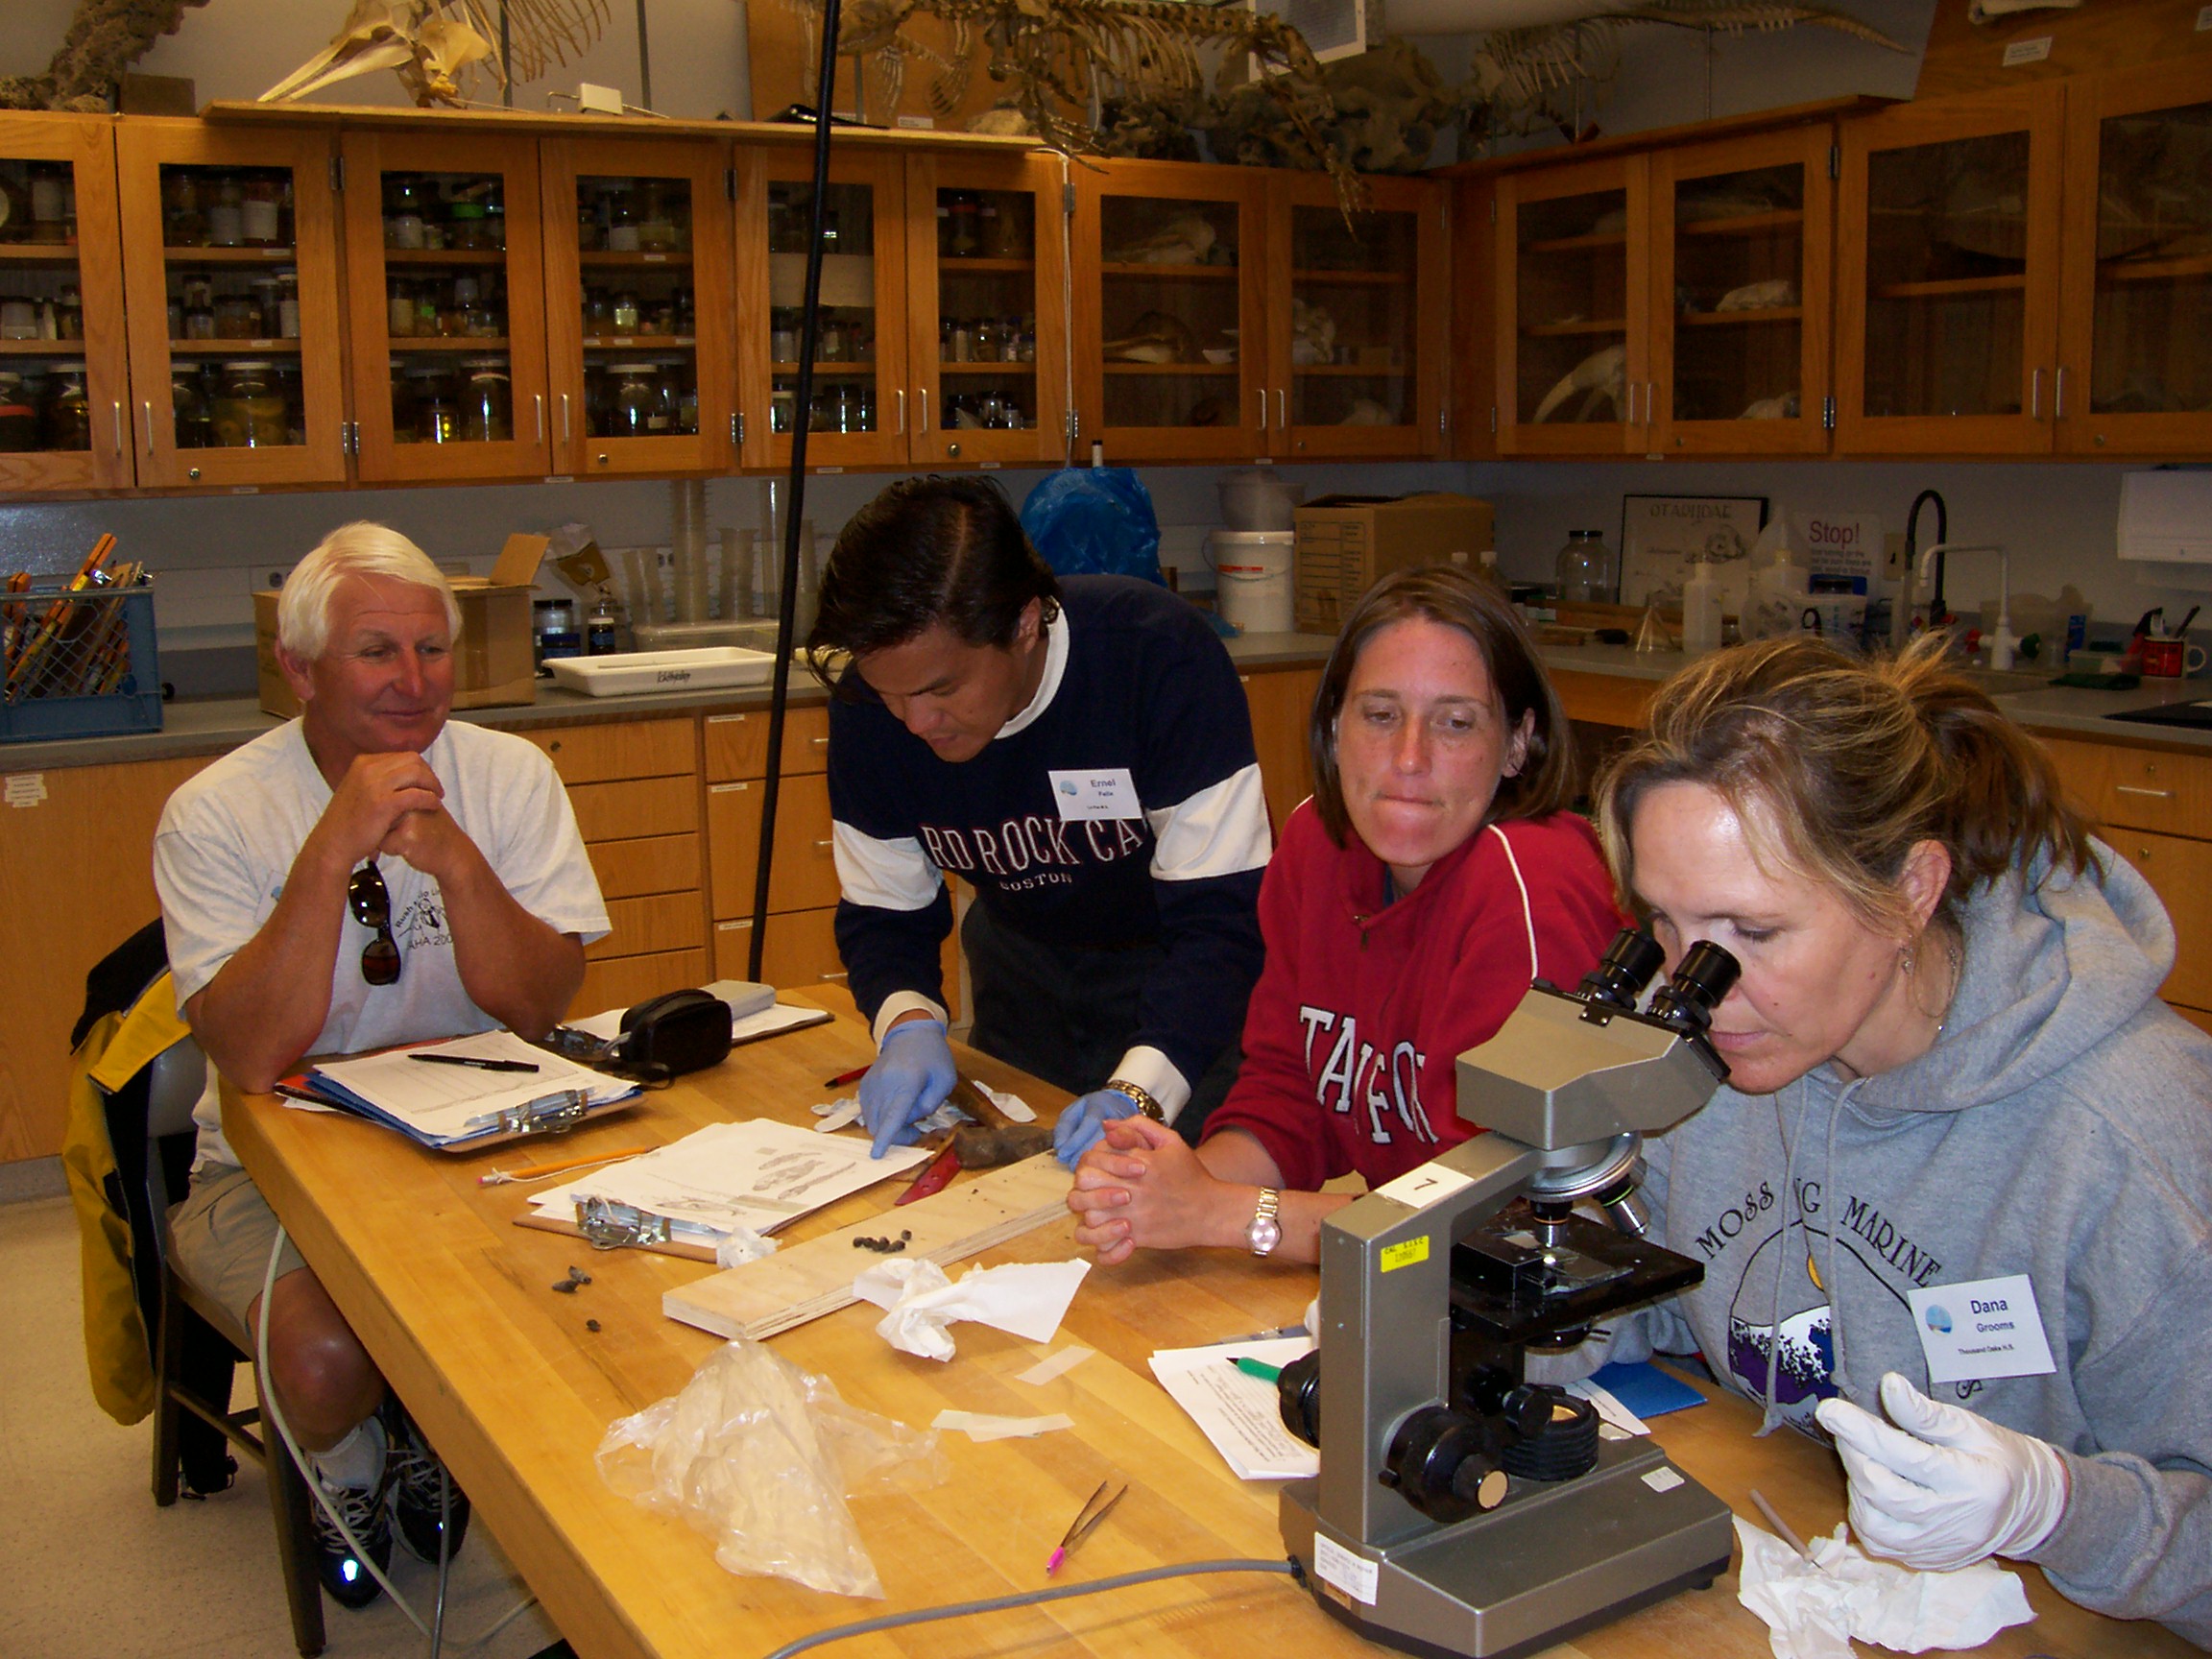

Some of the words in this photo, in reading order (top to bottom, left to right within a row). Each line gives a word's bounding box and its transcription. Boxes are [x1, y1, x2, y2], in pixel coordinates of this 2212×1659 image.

[1809, 520, 1860, 549] Stop!
[973, 816, 1081, 876] ROCK
[1084, 819, 1147, 862] CA
[998, 873, 1072, 891] BOSTON
[1413, 1177, 1438, 1190] 7
[1695, 1181, 1774, 1260] MOSS
[1840, 1195, 1942, 1288] MARINE
[1970, 1299, 2008, 1313] Dana
[1976, 1322, 2014, 1333] Grooms
